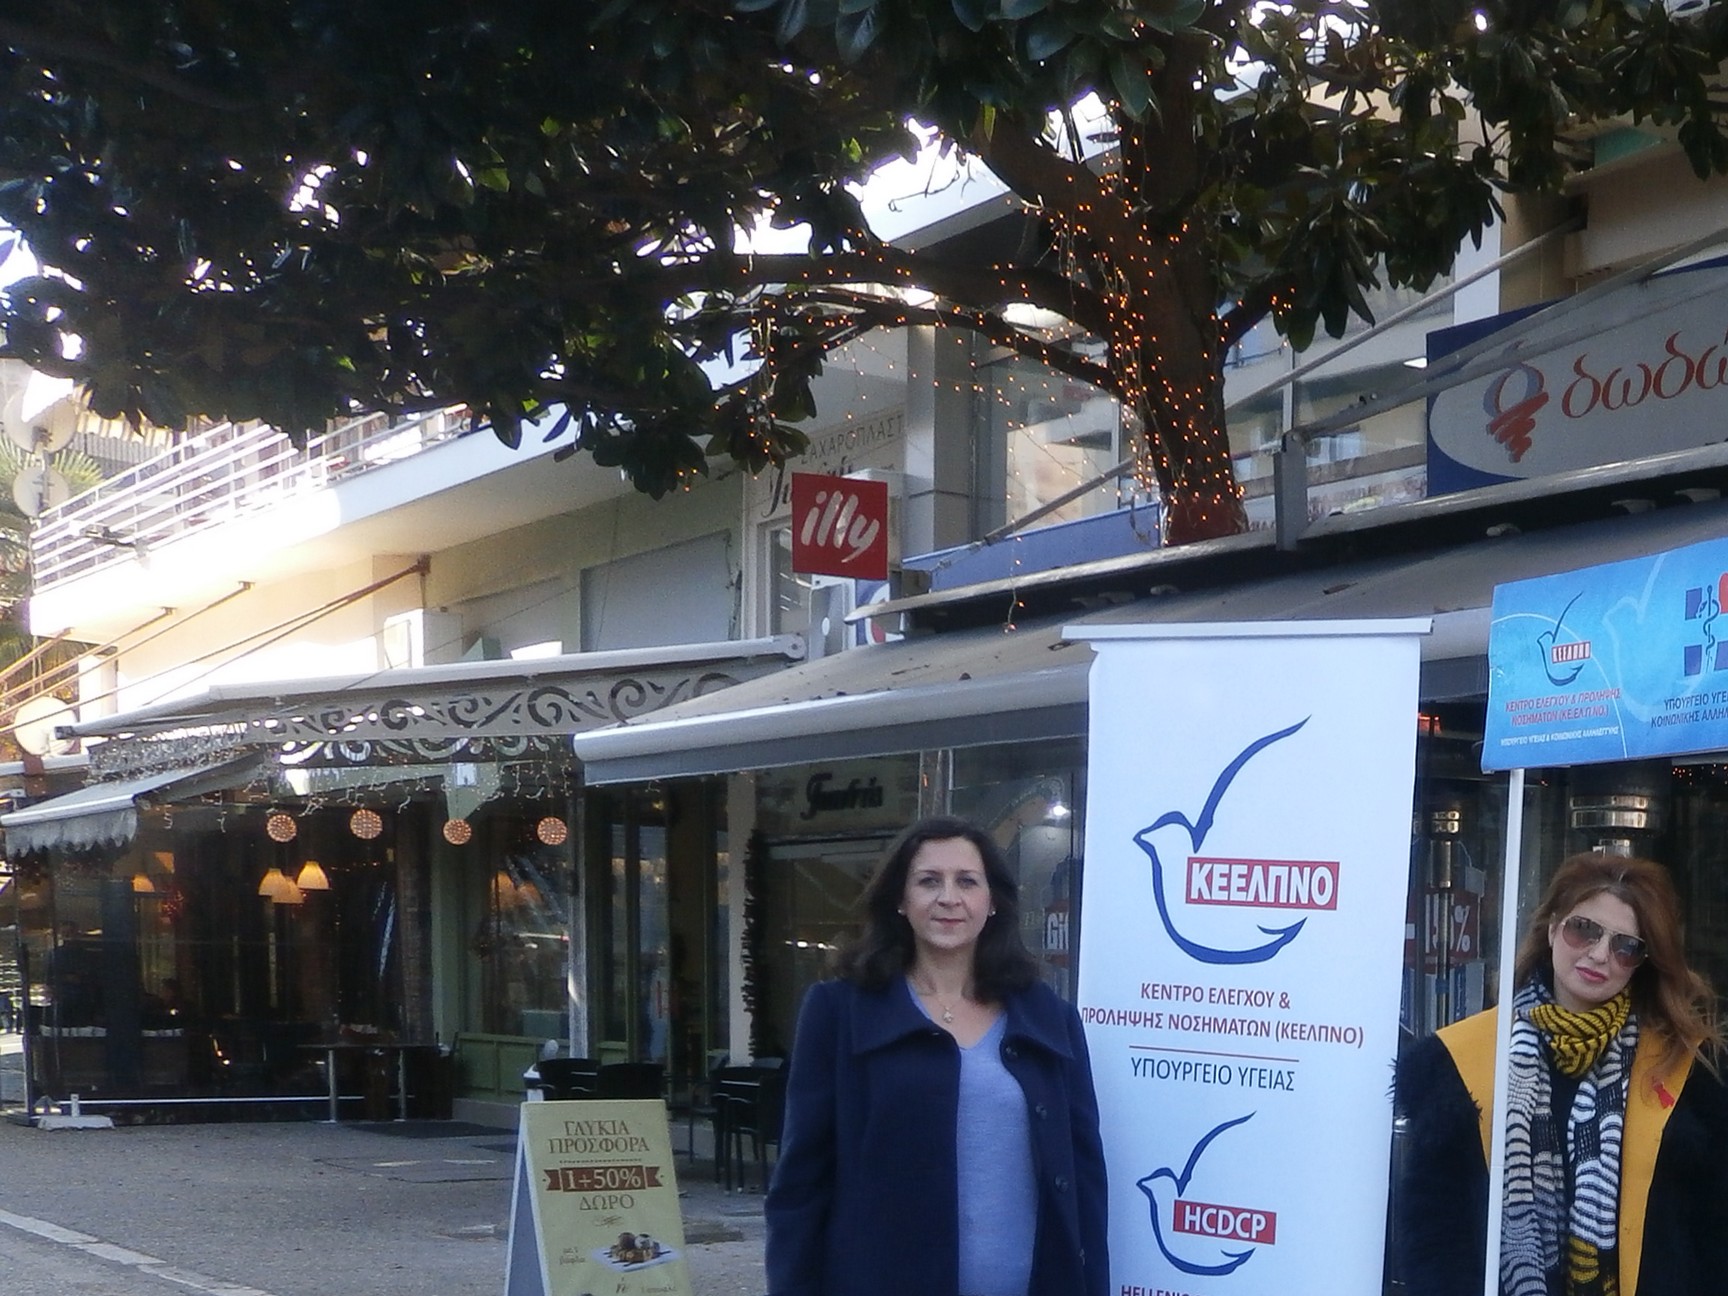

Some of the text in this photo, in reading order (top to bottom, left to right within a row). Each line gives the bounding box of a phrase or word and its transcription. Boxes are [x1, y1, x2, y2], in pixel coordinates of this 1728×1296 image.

[801, 490, 880, 563] illy
[1664, 693, 1709, 711] ΥΠΟΥΡΓΕΙΟ
[1190, 862, 1335, 907] ΚΕΕΛΠΝΟ
[1141, 983, 1291, 1010] ΚΕΝΤΡΟ ΕΛΕΓΧΟΥ &
[1081, 1007, 1365, 1049] ΠΡΟΛΗΨΗΣ ΝΟΣΗΜΑΤΩΝ (ΚΕΕΛΠΝΟ)
[1131, 1056, 1296, 1092] ΥΠΟΥΡΓΕΙΟ ΥΓΕΙΑΣ
[549, 1136, 650, 1155] ΠΡΟΣΦΟΡΑ
[578, 1194, 635, 1211] ΔΩΡΟ
[1184, 1205, 1267, 1240] HCDCP
